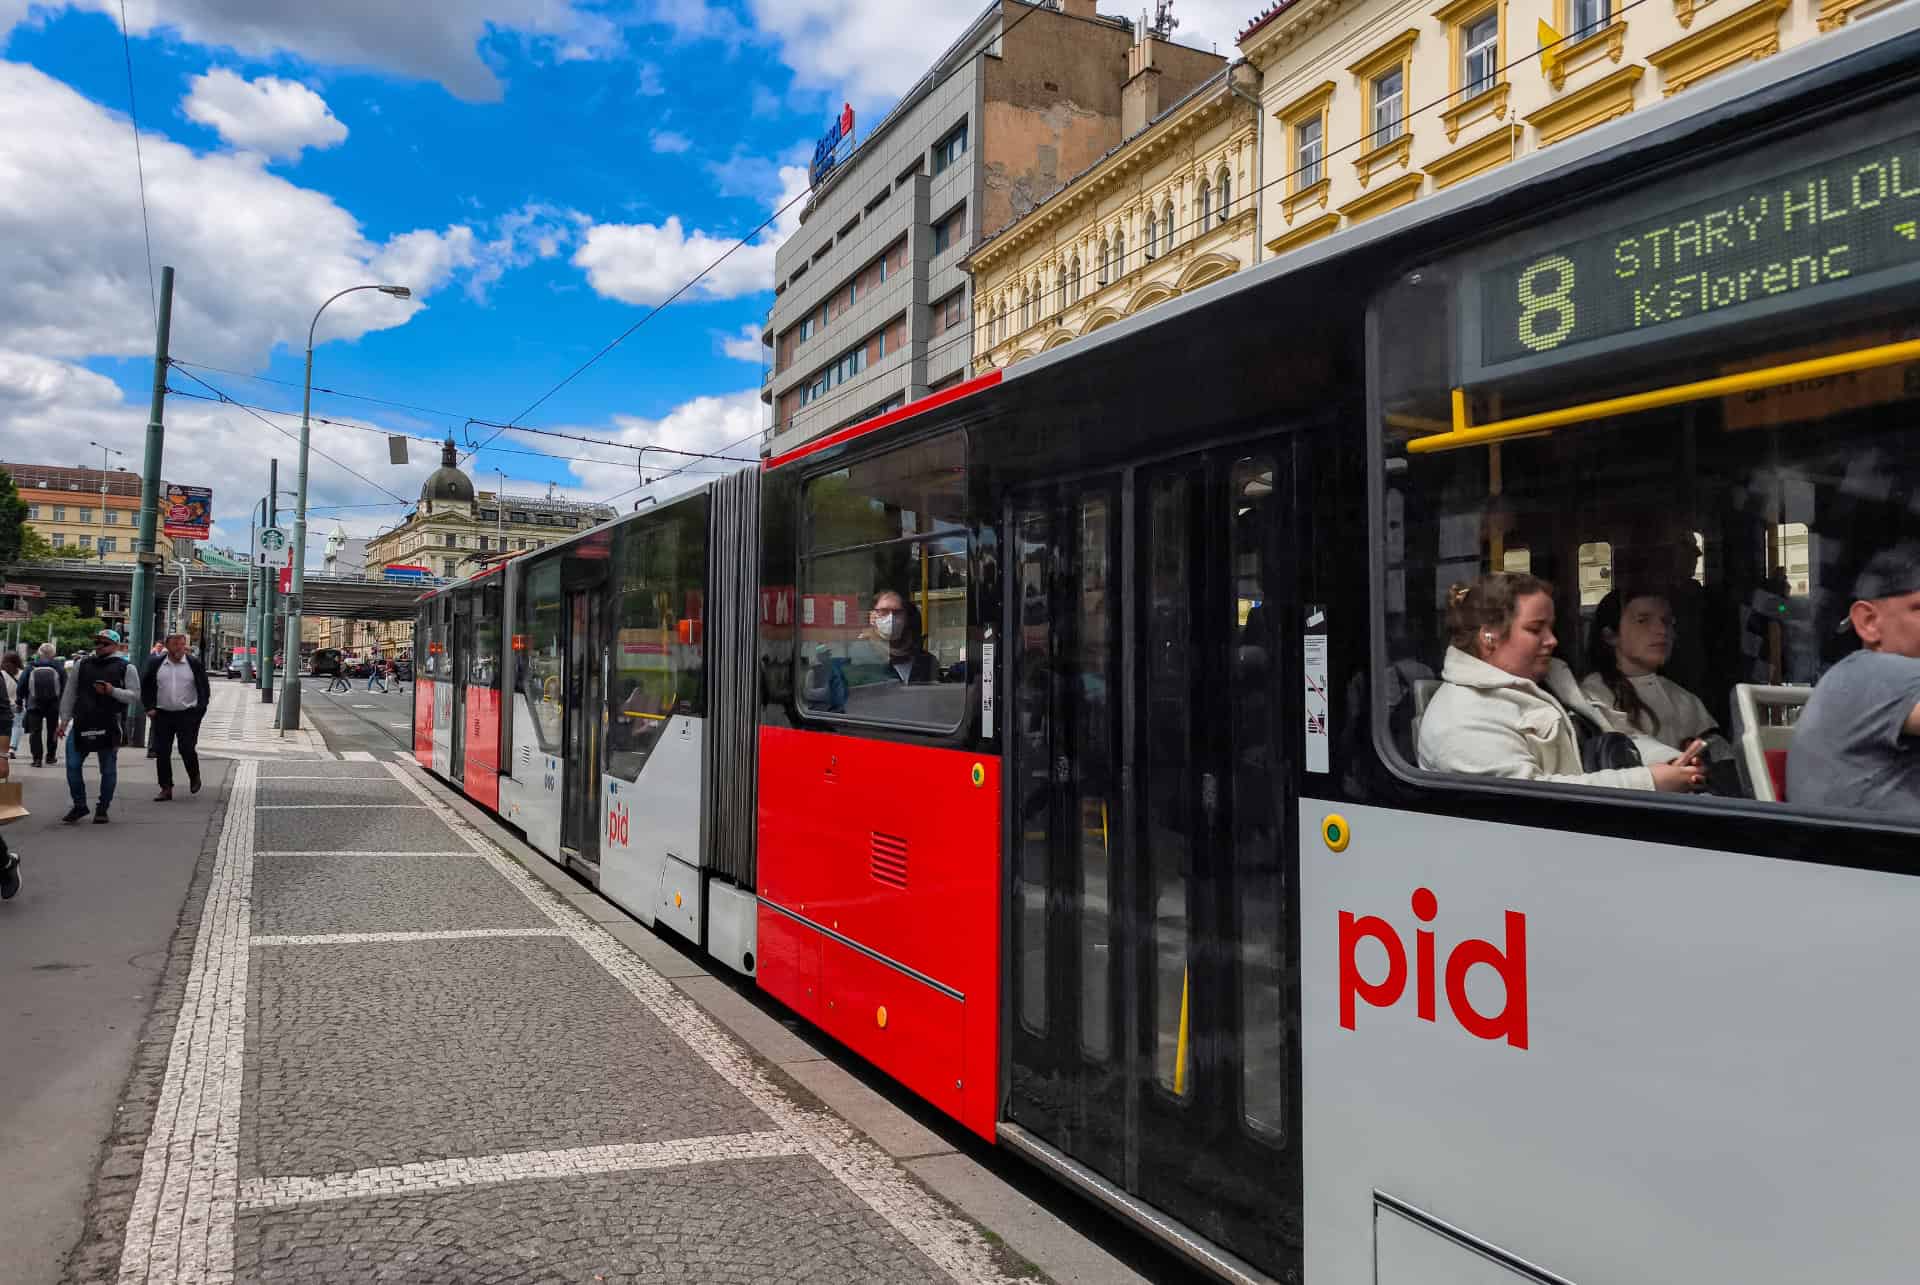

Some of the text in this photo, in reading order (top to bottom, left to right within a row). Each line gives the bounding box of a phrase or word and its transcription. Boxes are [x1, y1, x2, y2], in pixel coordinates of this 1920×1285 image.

[1518, 256, 1576, 351] 8
[609, 802, 629, 848] pid
[1338, 886, 1529, 1051] pid
